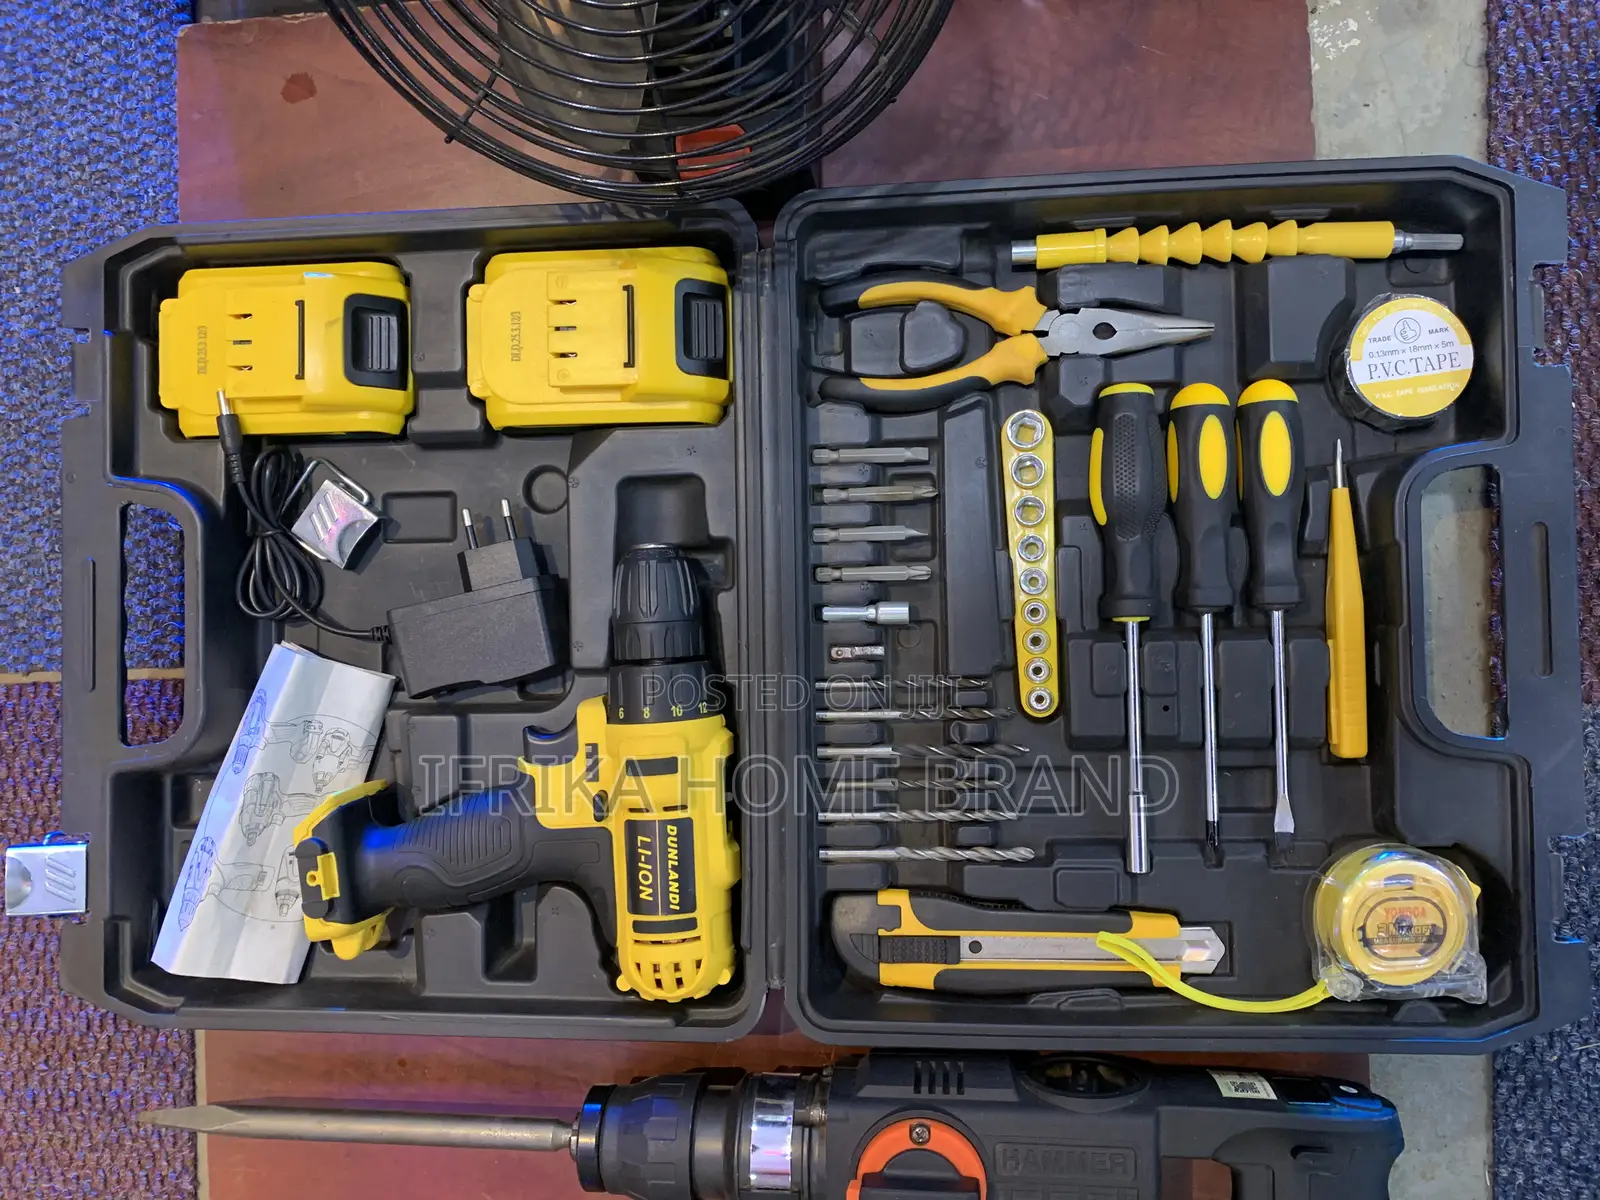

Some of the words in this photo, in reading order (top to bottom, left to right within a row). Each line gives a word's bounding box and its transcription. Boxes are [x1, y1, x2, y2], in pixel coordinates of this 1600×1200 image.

[1368, 335, 1392, 344] TRADE
[1428, 326, 1450, 335] MARK
[1368, 348, 1400, 359] 0.13mm
[1408, 343, 1433, 354] 18mm
[1441, 340, 1455, 348] 5m
[618, 707, 625, 720] 6
[643, 706, 650, 719] 8
[670, 704, 683, 717] 10
[697, 701, 709, 714] 12
[637, 835, 654, 901] LI-ION
[667, 824, 680, 911] DUNLANDI
[1001, 1148, 1128, 1176] HAMMER
